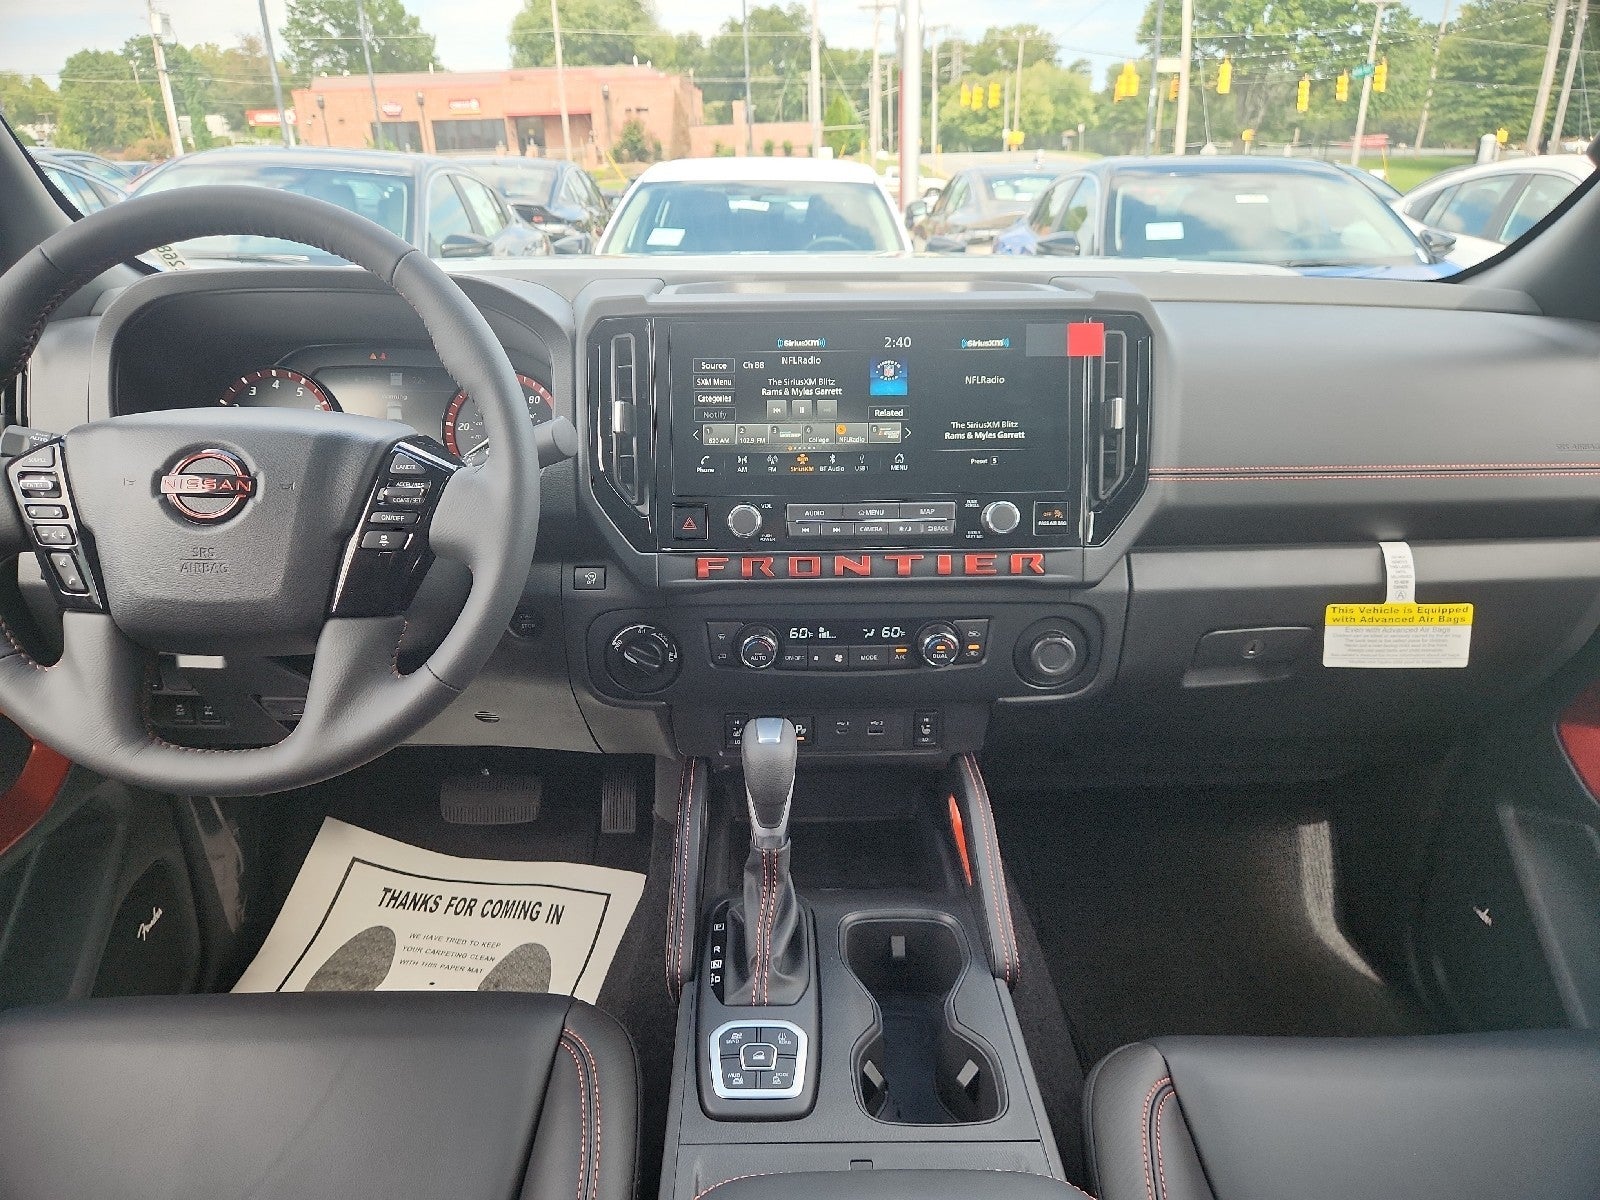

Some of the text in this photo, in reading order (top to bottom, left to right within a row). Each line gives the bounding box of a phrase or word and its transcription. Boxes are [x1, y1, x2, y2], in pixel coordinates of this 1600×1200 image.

[884, 337, 912, 348] 2:40
[781, 356, 822, 365] NFLRadio
[701, 361, 728, 370] Source
[272, 379, 280, 390] 4
[696, 378, 732, 386] SXM Menu
[767, 378, 836, 386] The SiriusXM Blitz
[965, 376, 1005, 384] NFLRadio
[249, 387, 257, 396] 3
[296, 388, 304, 397] 5
[761, 388, 843, 397] Rams & Myles Garrett
[528, 396, 540, 404] 80
[697, 395, 732, 404] Categories
[703, 410, 727, 420] Notify
[874, 409, 904, 417] Related
[457, 422, 470, 431] 20
[951, 420, 1019, 429] The SiriusXM Blitz
[944, 431, 1026, 441] Rams & Myles Garrett
[164, 478, 252, 492] NISSAN
[191, 547, 215, 557] SRS
[180, 562, 229, 574] AIRBAG
[696, 554, 1045, 577] FRONTIER
[1331, 606, 1469, 615] This Vehicle is Equipped
[1439, 615, 1466, 624] Bags
[378, 886, 566, 925] THANKS FOR COMING IN
[446, 937, 467, 945] TRIED
[713, 945, 721, 953] R
[425, 949, 468, 959] CARPETING
[469, 954, 496, 962] CLEAN
[439, 964, 466, 972] PAPER
[715, 975, 721, 983] D
